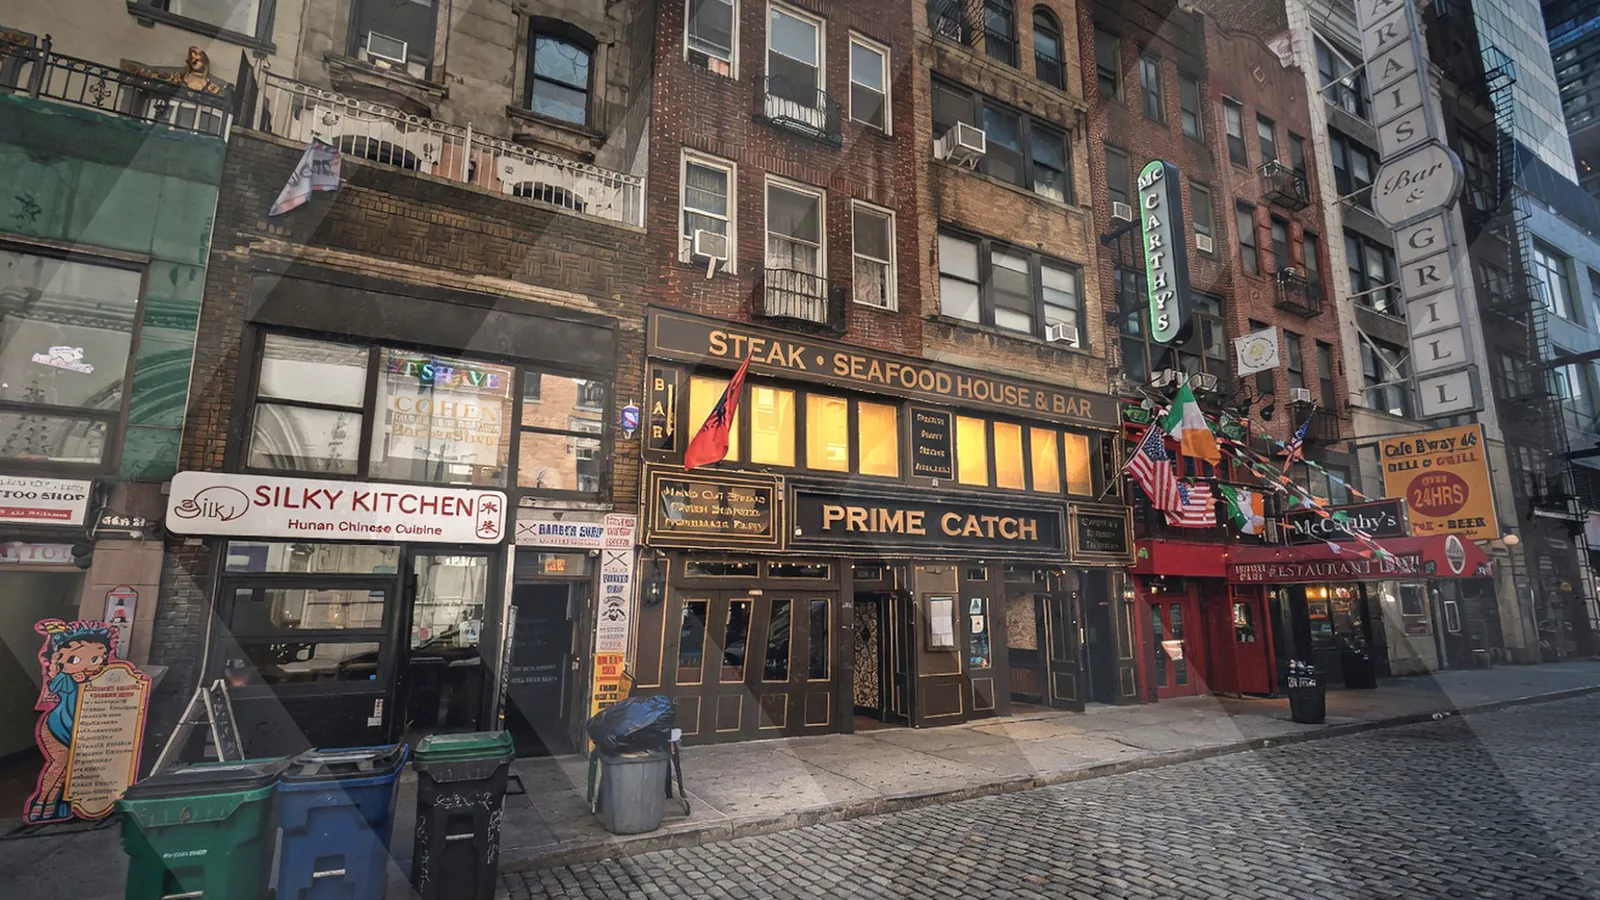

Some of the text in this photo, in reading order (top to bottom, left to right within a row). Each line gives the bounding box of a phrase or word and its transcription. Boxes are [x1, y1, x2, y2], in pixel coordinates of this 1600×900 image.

[1384, 162, 1443, 195] Bar
[1409, 228, 1457, 404] GRILL
[708, 330, 1093, 419] STEAK SEAFOOD HOUSE & BAR
[0, 490, 37, 499] TOO
[253, 485, 474, 517] SILKY KITCHEN
[1413, 483, 1464, 508] 24HRS
[288, 519, 334, 531] Hunan
[338, 521, 392, 533] Chinese
[822, 504, 1038, 541] PRIME CATCH
